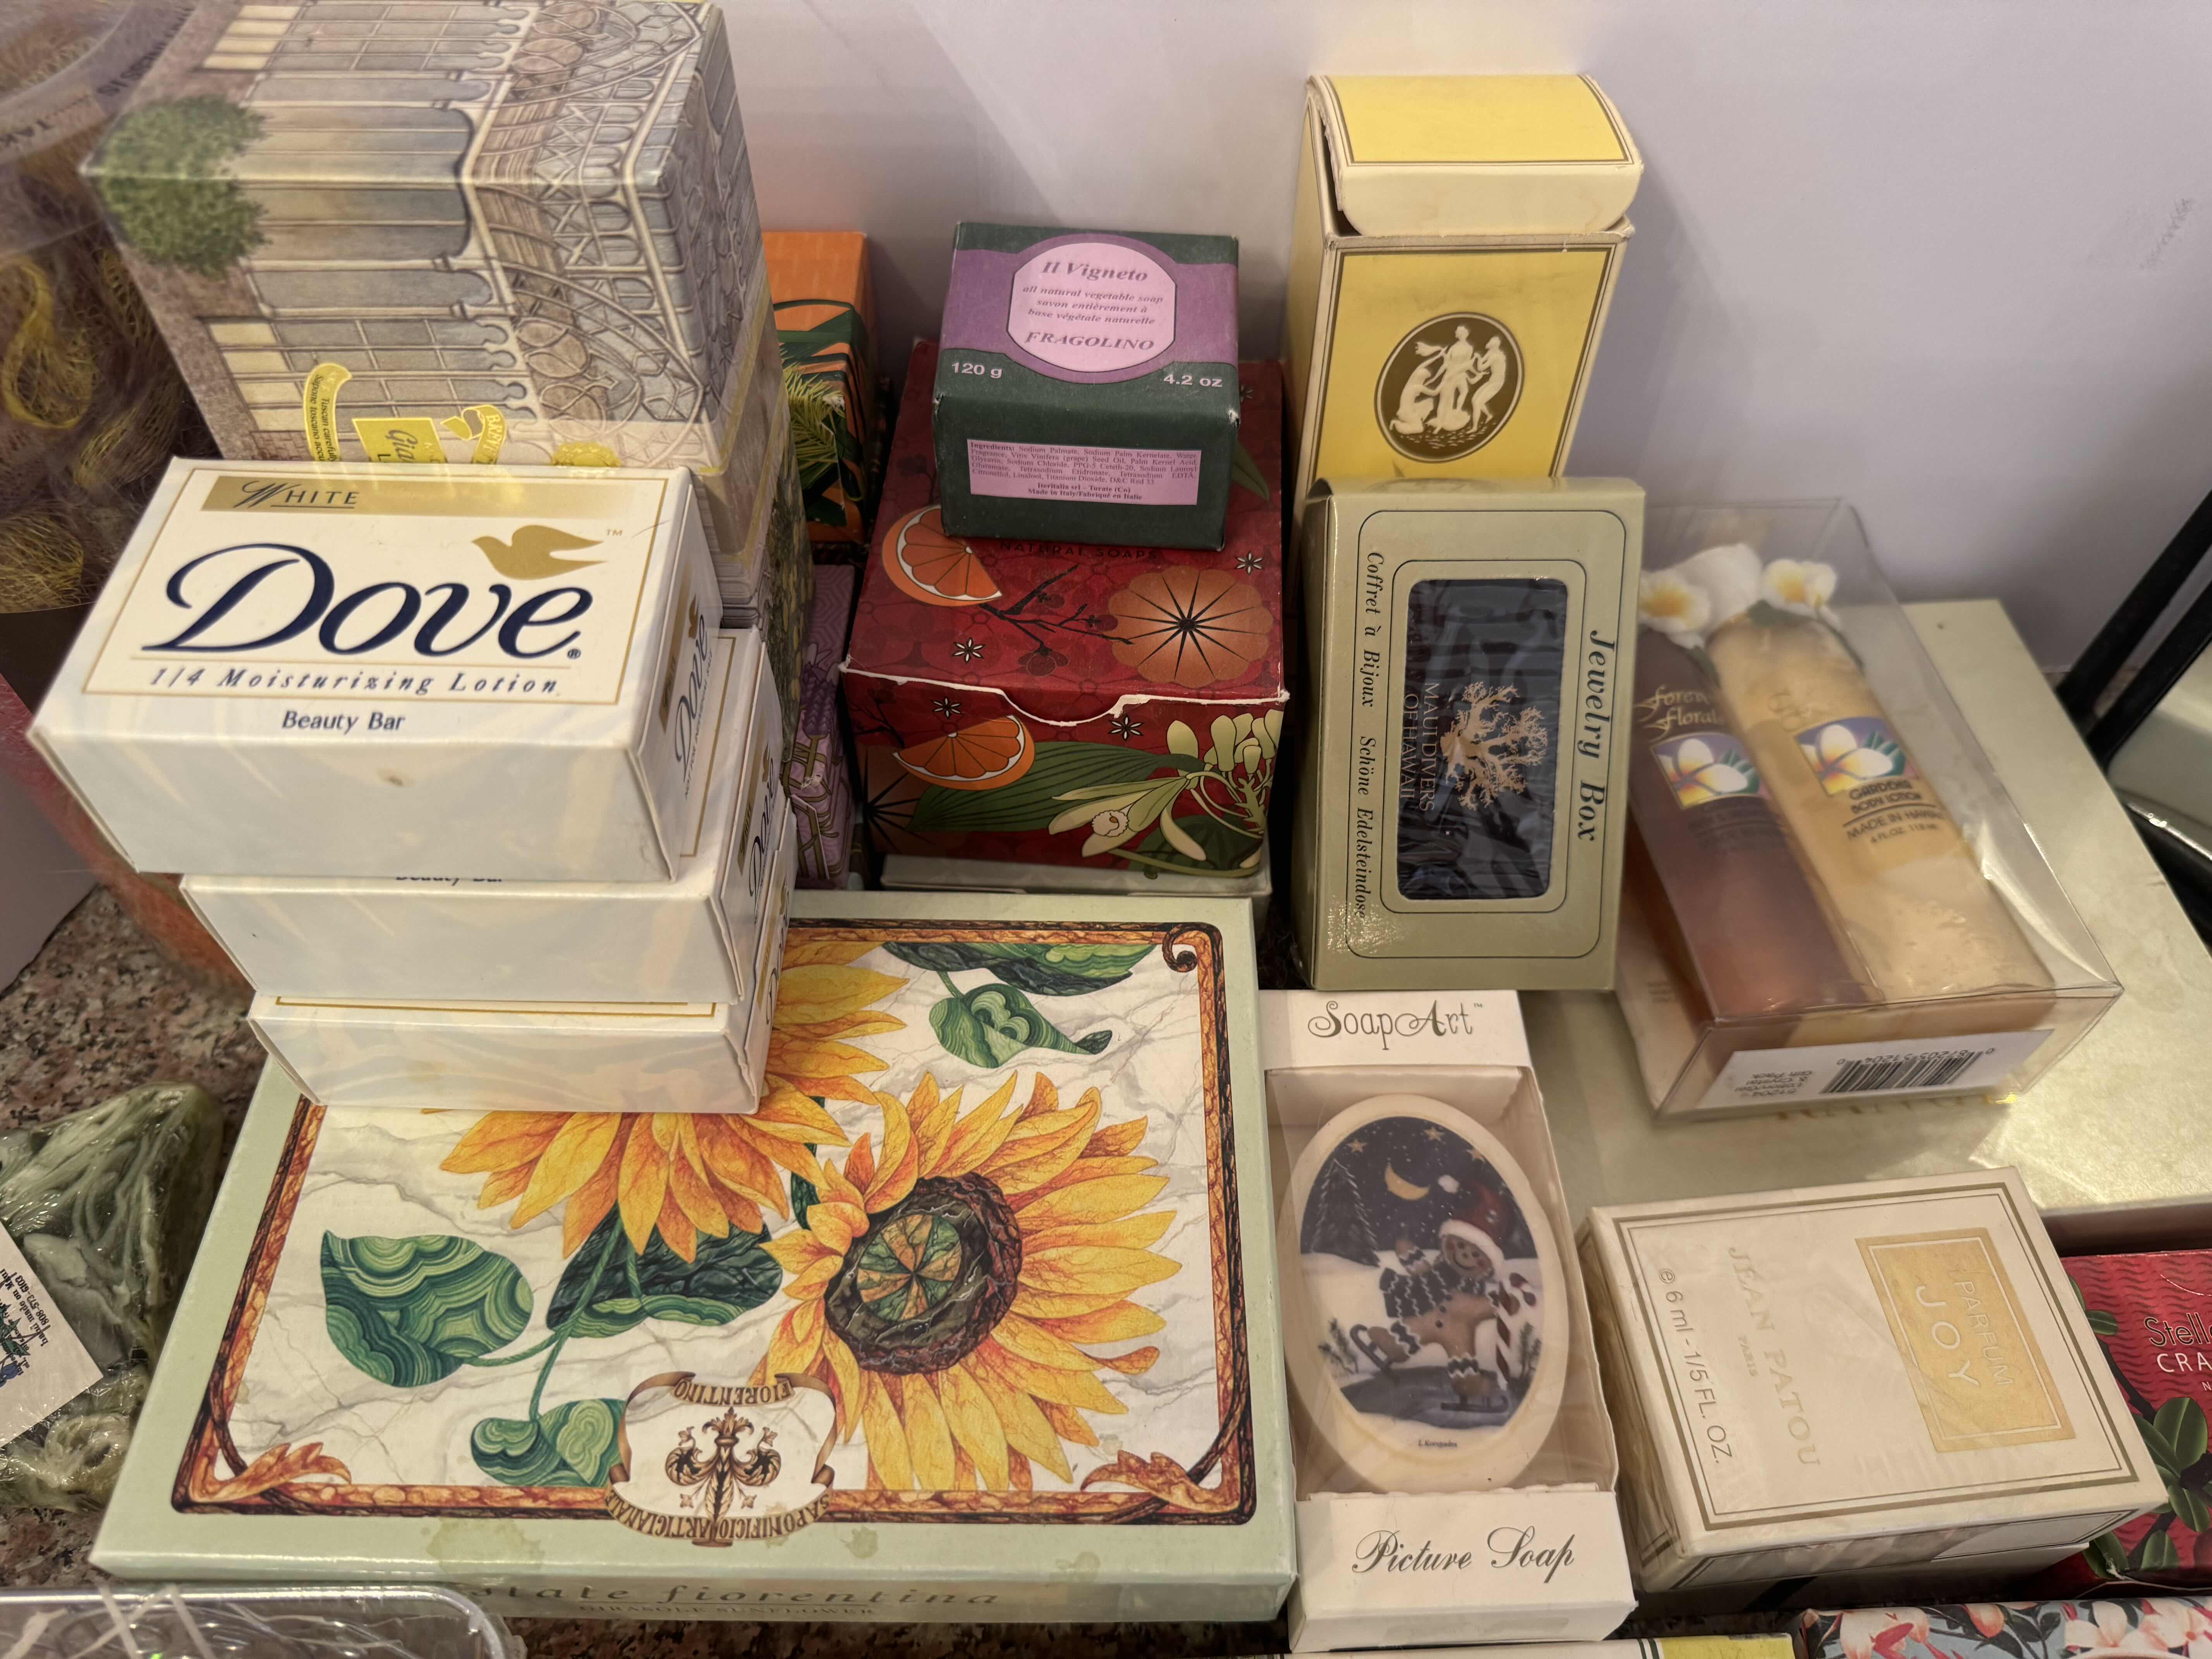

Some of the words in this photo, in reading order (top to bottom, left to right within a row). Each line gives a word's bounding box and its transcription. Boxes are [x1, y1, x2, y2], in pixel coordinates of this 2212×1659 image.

[1041, 262, 1061, 274] Il
[1065, 263, 1148, 282] Vigneto
[1022, 285, 1037, 294] all
[1041, 287, 1081, 297] natural
[1084, 291, 1135, 303] vegetable
[1138, 295, 1163, 304] soap
[1037, 301, 1068, 309] savon
[1072, 302, 1135, 313] entièrement
[1028, 309, 1053, 319] base
[1056, 311, 1101, 323] végétale
[1104, 315, 1155, 325] naturelle
[1024, 331, 1155, 351] FRAGOLINO
[951, 362, 986, 375] 120
[990, 368, 1003, 379] g
[1163, 374, 1192, 386] 4.2
[1199, 377, 1223, 388] oz
[321, 398, 330, 426] Tuscan
[971, 442, 1015, 452] Ingredients:
[232, 480, 360, 509] WHITE
[1000, 542, 1084, 557] NATURAL
[1096, 547, 1158, 560] SOAPS
[1365, 551, 1384, 615] Coffret
[141, 542, 594, 660] Dove
[1365, 626, 1377, 637] à
[148, 667, 205, 688] 1/4
[216, 669, 434, 696] Moisturizing
[451, 672, 561, 694] Lotion
[1359, 649, 1380, 708] Bijoux
[1577, 630, 1616, 759] Jewelry
[674, 613, 708, 785] Dove
[1403, 694, 1419, 718] OF
[1422, 682, 1440, 738] MAUI
[282, 711, 359, 735] Beauty
[369, 713, 406, 732] Bar
[1358, 736, 1377, 796] Schöne
[1399, 722, 1418, 799] HAWAII
[1419, 743, 1437, 812] DIVERS
[1577, 780, 1605, 842] Box
[1354, 807, 1374, 919] Edelsteindose
[1308, 1000, 1474, 1050] SoapArt
[1666, 1290, 1684, 1303] 6
[1670, 1309, 1694, 1333] ml
[1915, 1285, 1980, 1388] JOY
[1954, 1281, 2014, 1386] PARFUM
[2144, 1312, 2212, 1346] Stell
[1684, 1350, 1709, 1382] 1/5
[1728, 1247, 1776, 1331] JEAN
[1764, 1348, 1820, 1466] PATOU
[1738, 1336, 1759, 1377] PARIS
[674, 1379, 790, 1405] FIORENTINO
[1694, 1388, 1717, 1419] FL.
[1707, 1425, 1732, 1464] OZ.
[604, 1490, 711, 1539] ARTIGIANALE
[719, 1494, 830, 1539] SAPONIFICIO
[1352, 1530, 1472, 1573] Picture
[1487, 1525, 1576, 1583] Soap
[469, 1584, 630, 1600] state
[662, 1584, 999, 1605] fiorentina
